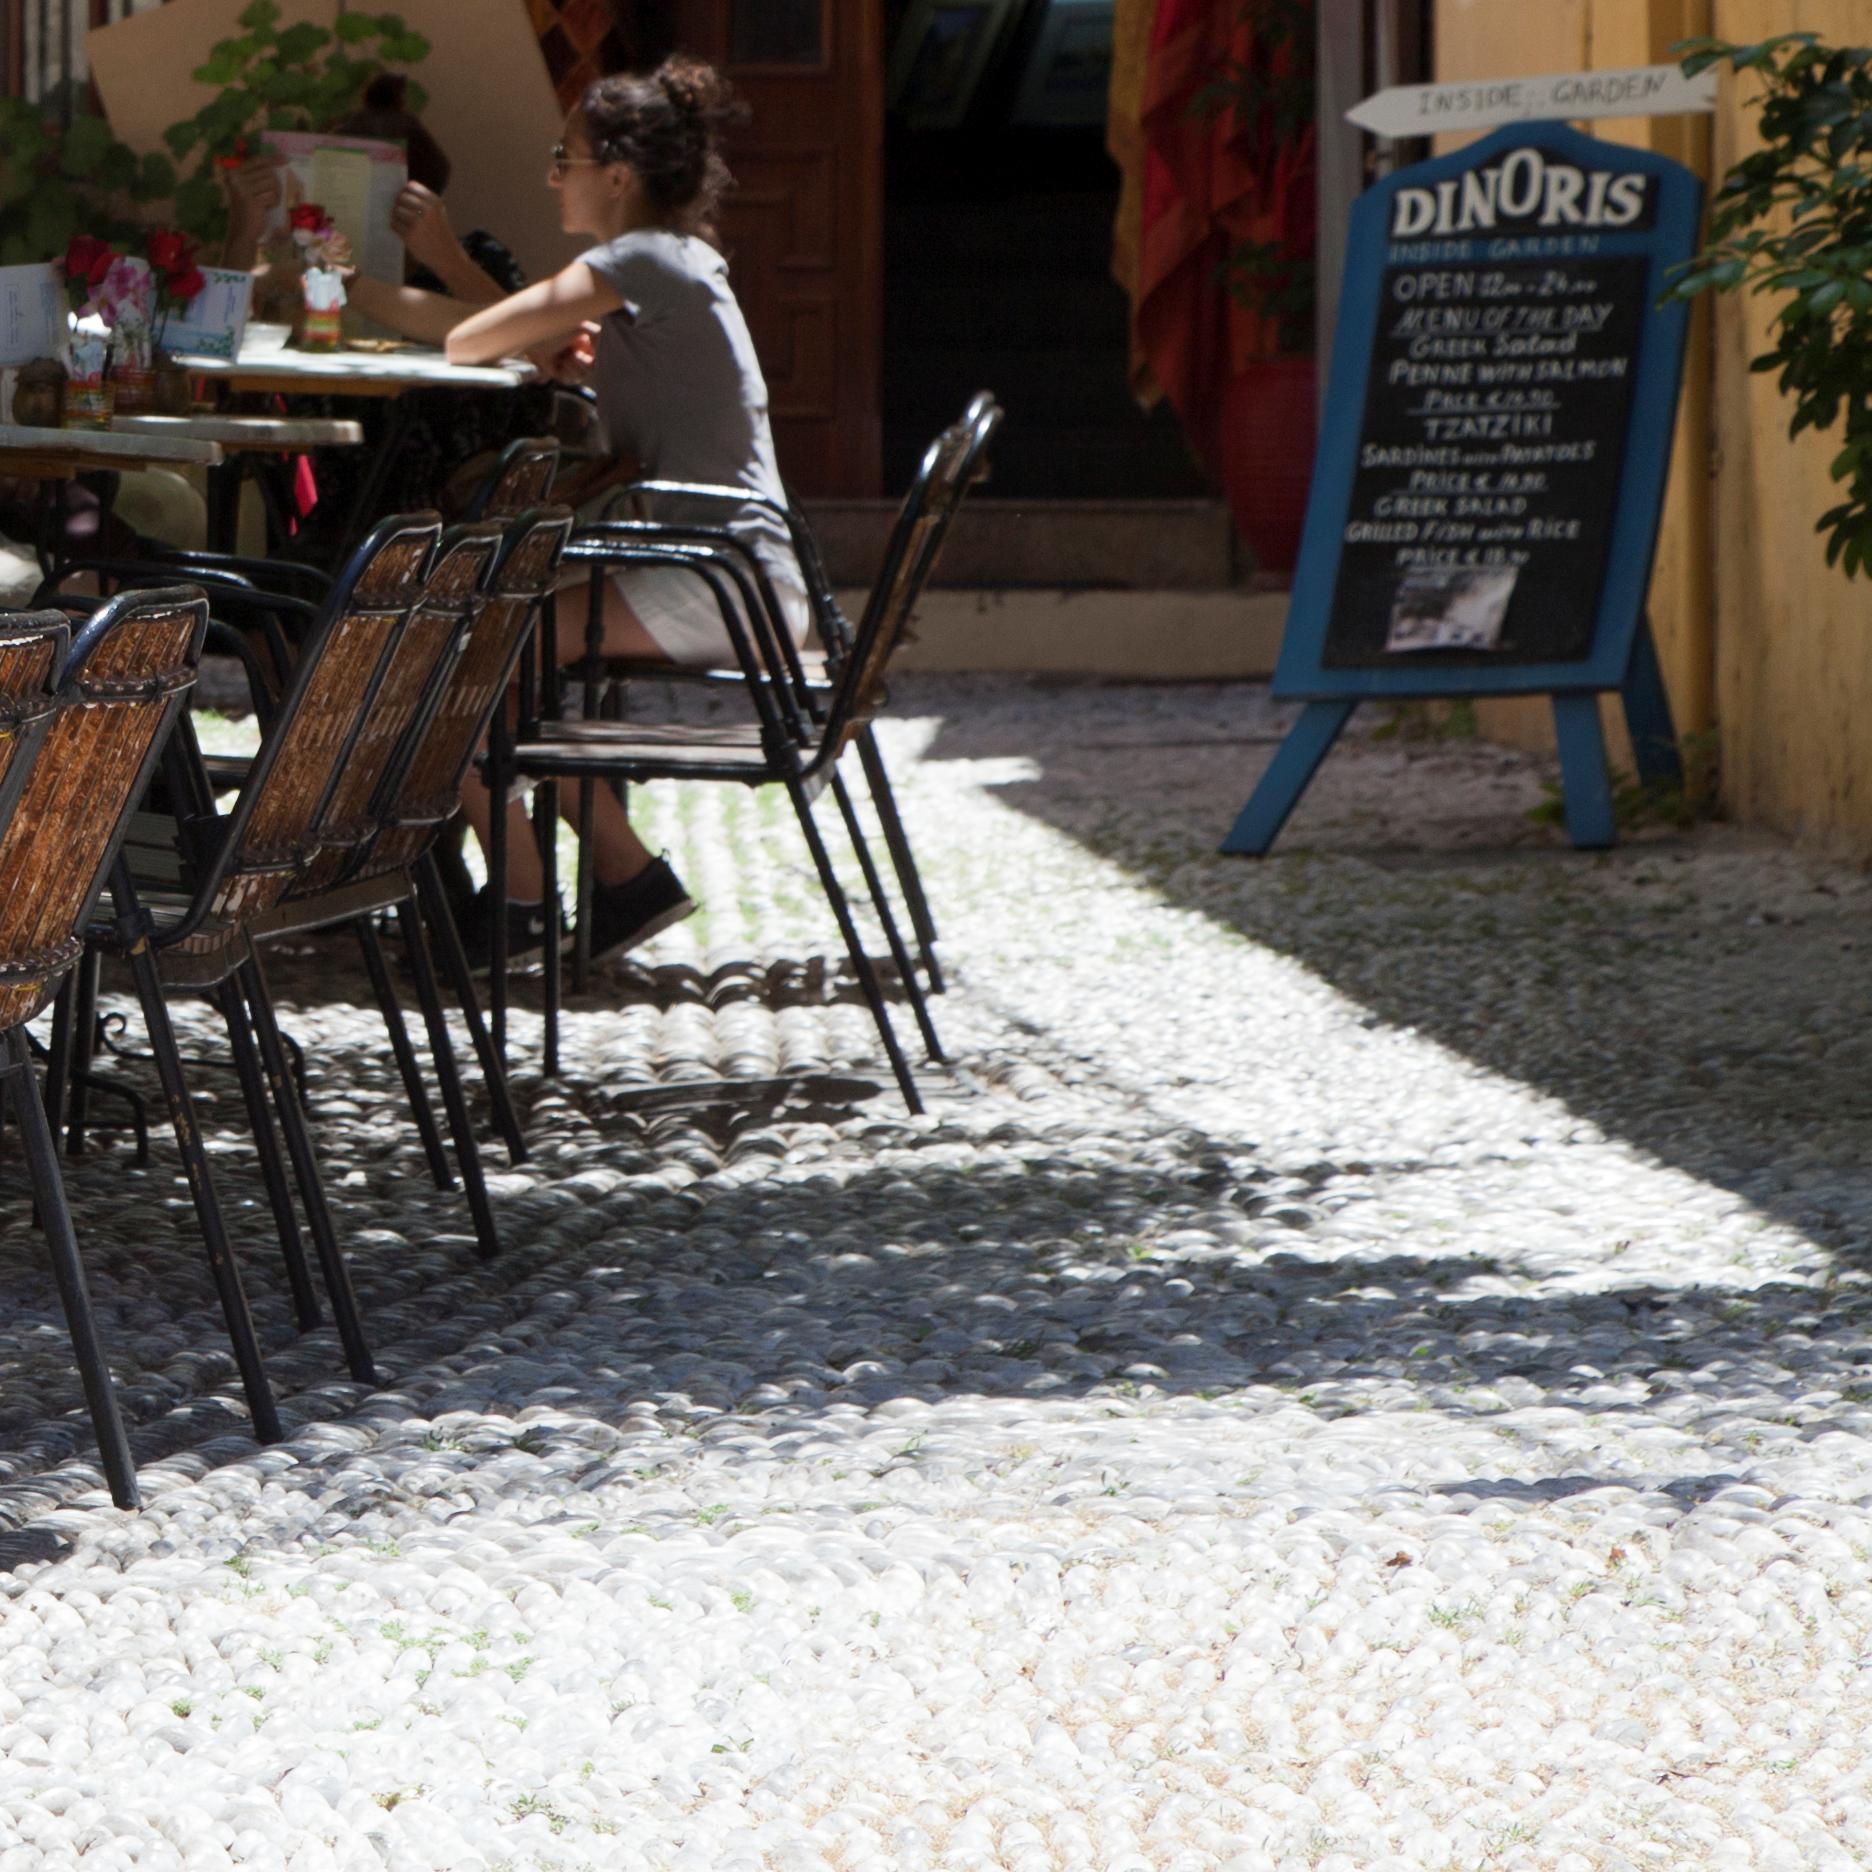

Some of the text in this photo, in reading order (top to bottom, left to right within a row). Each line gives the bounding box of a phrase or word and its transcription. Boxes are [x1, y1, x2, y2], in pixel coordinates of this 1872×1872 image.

[1550, 73, 1668, 104] GARDEN
[1392, 147, 1648, 239] DINORIS
[1390, 234, 1601, 263] INSIDE GARDEN
[1392, 272, 1475, 302] OPEN
[1395, 302, 1615, 332] MENU OF THE DAY
[1492, 331, 1578, 357] Salad
[1388, 358, 1474, 386] PENNE
[1536, 357, 1629, 383] SALMON
[1424, 413, 1553, 441] TZATZIKI
[1372, 495, 1529, 518] GREEK SALAD
